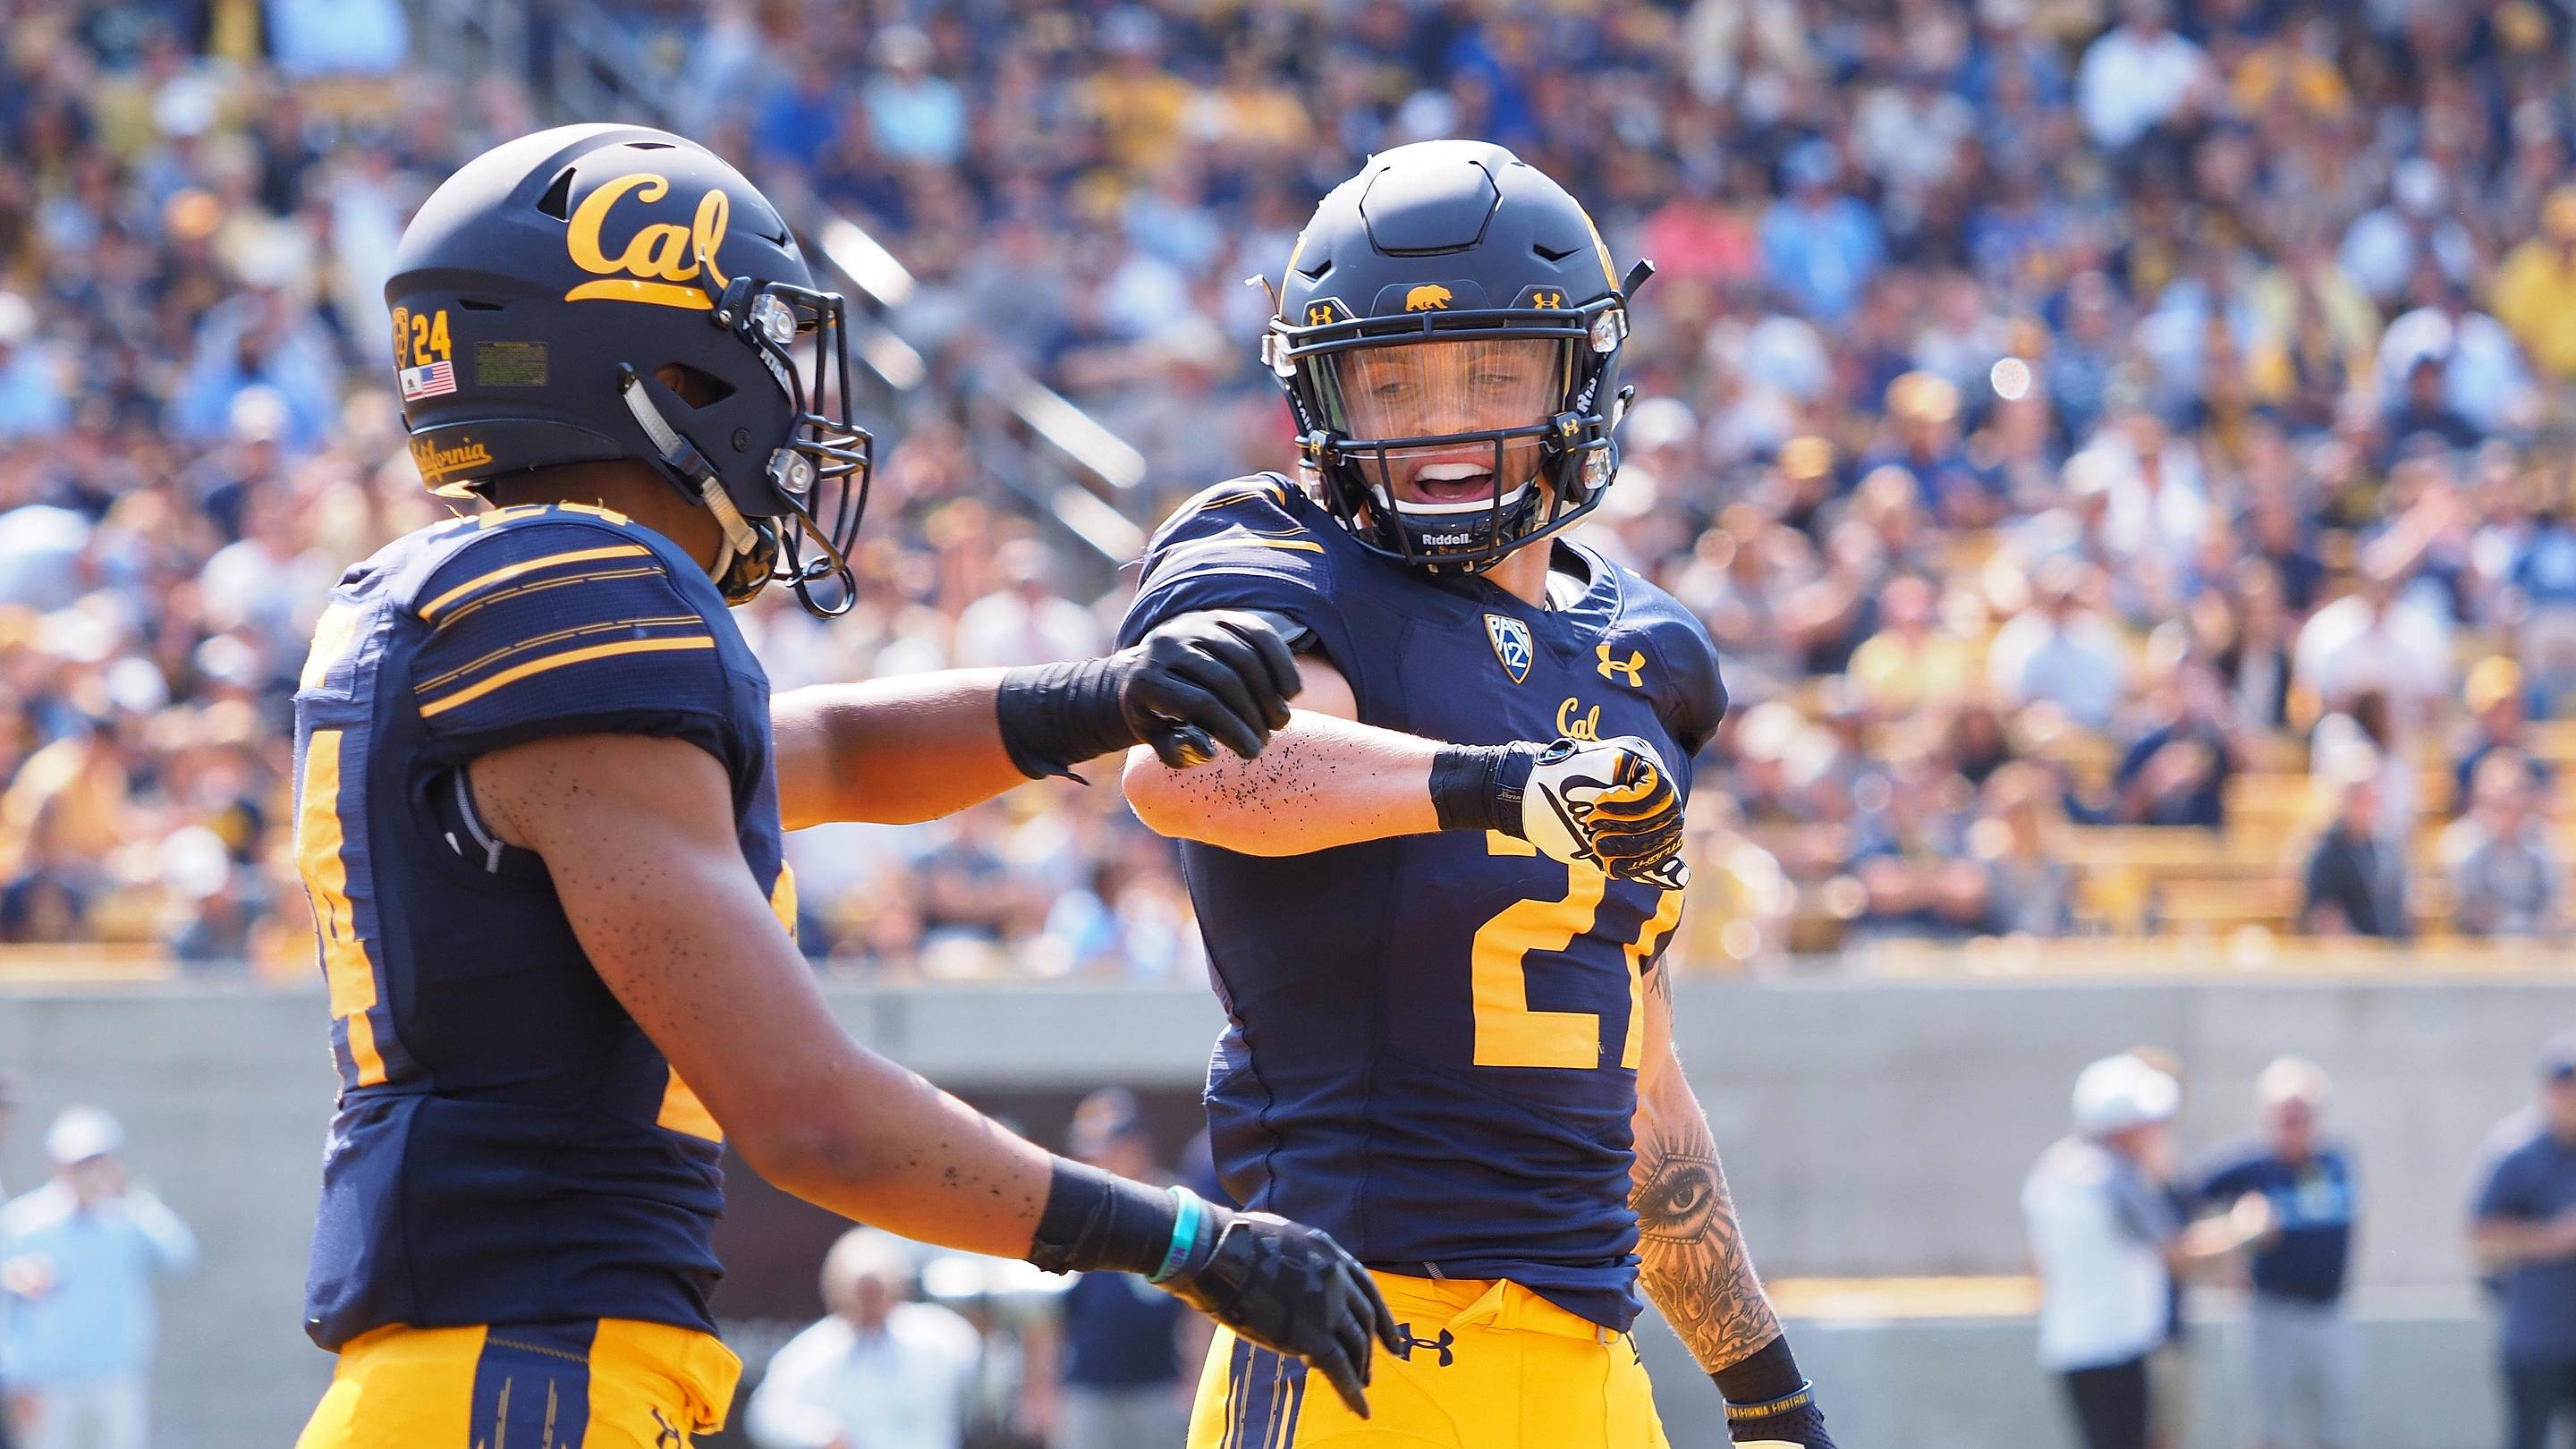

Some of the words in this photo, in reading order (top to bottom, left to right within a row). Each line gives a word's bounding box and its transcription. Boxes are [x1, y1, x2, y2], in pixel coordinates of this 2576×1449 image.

[567, 174, 729, 291] Cal
[411, 309, 452, 366] 24
[1422, 533, 1469, 545] Riddell
[1503, 641, 1528, 669] 12
[1556, 697, 1602, 741] Cal
